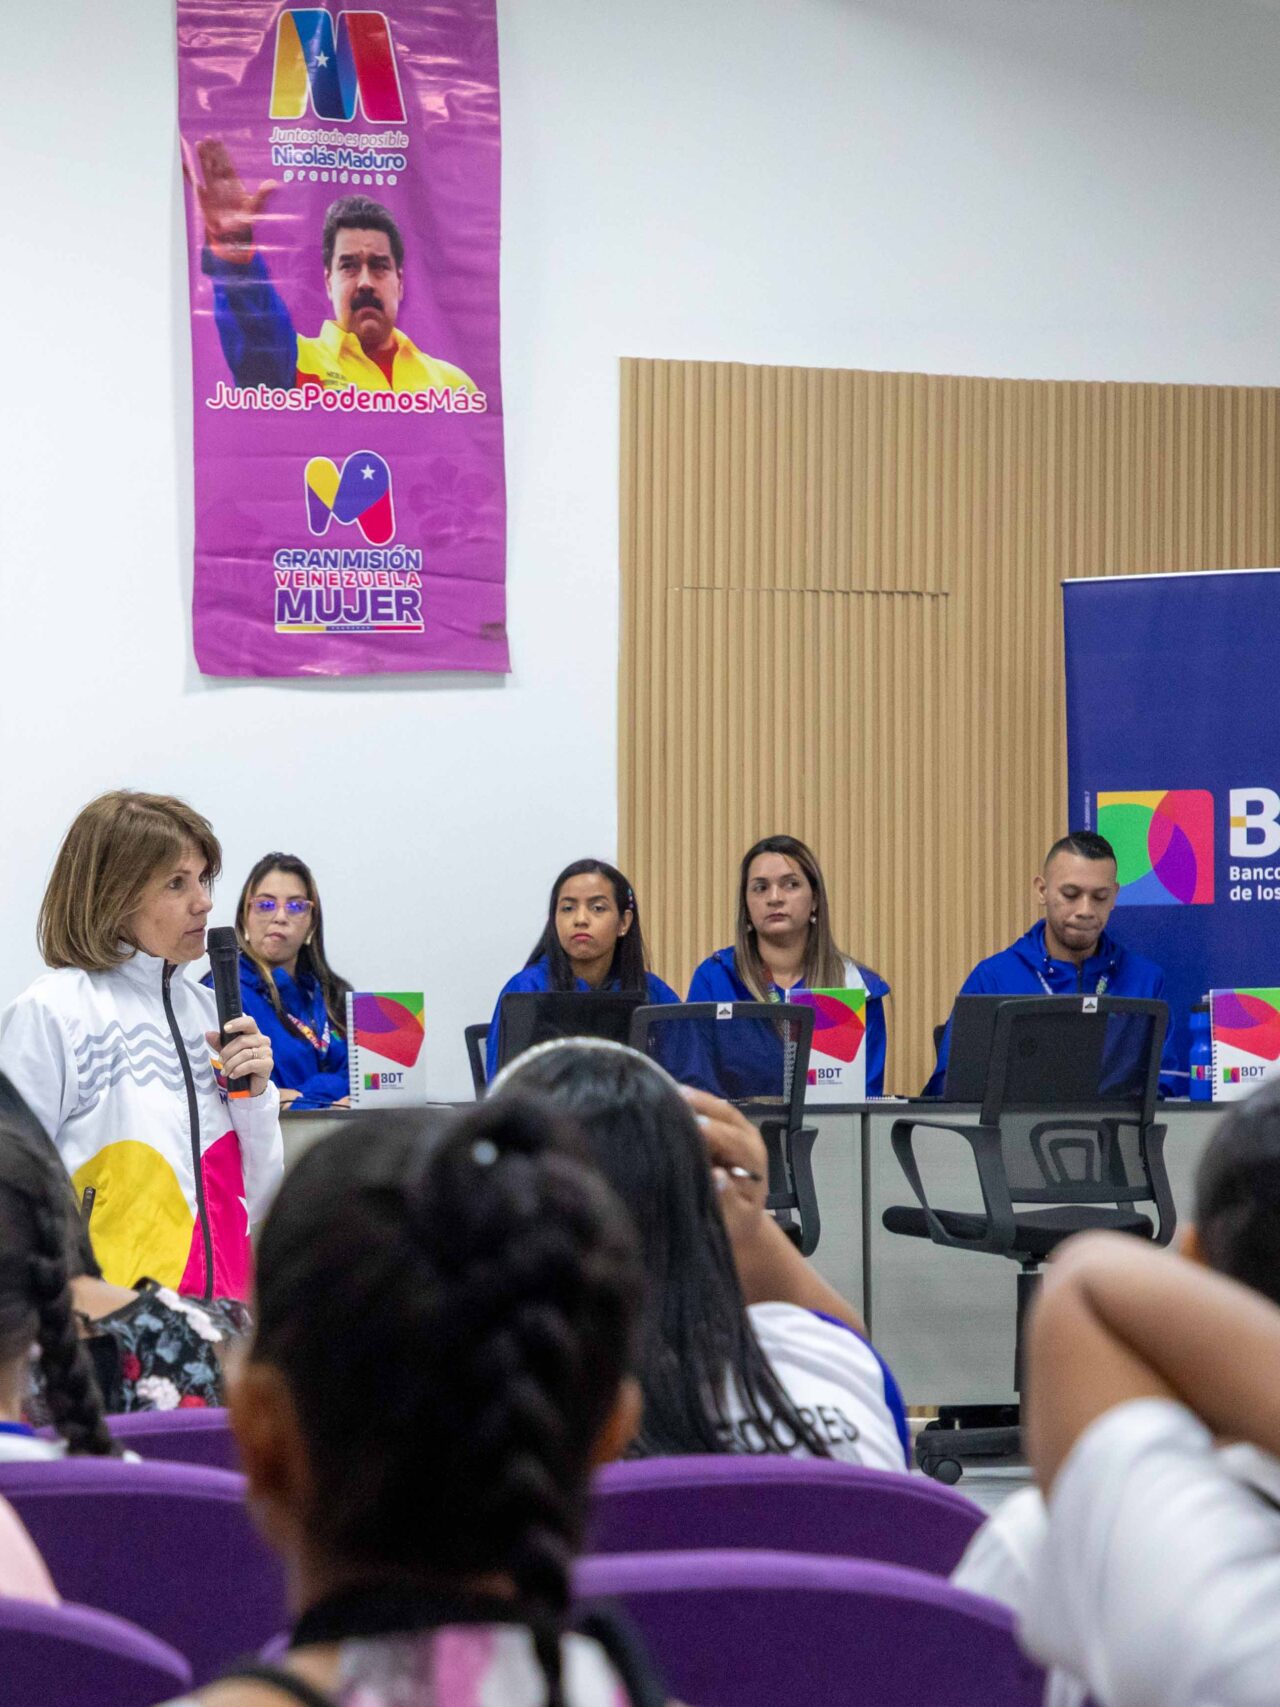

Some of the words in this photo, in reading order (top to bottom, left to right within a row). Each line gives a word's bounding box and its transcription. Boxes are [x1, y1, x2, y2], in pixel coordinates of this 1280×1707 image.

[269, 126, 317, 143] Juntos
[318, 128, 342, 145] todo
[344, 133, 358, 146] es
[359, 131, 409, 150] posible
[272, 144, 337, 168] Nicolás
[338, 148, 406, 171] Maduro
[274, 549, 340, 570] GRAN
[342, 544, 422, 570] MISIÓN
[275, 570, 422, 588] VENEZUELA
[275, 587, 424, 624] MUJER
[1229, 884, 1252, 901] de
[380, 1072, 404, 1084] BDT
[818, 1067, 842, 1079] BDT
[1241, 1066, 1267, 1077] BDT
